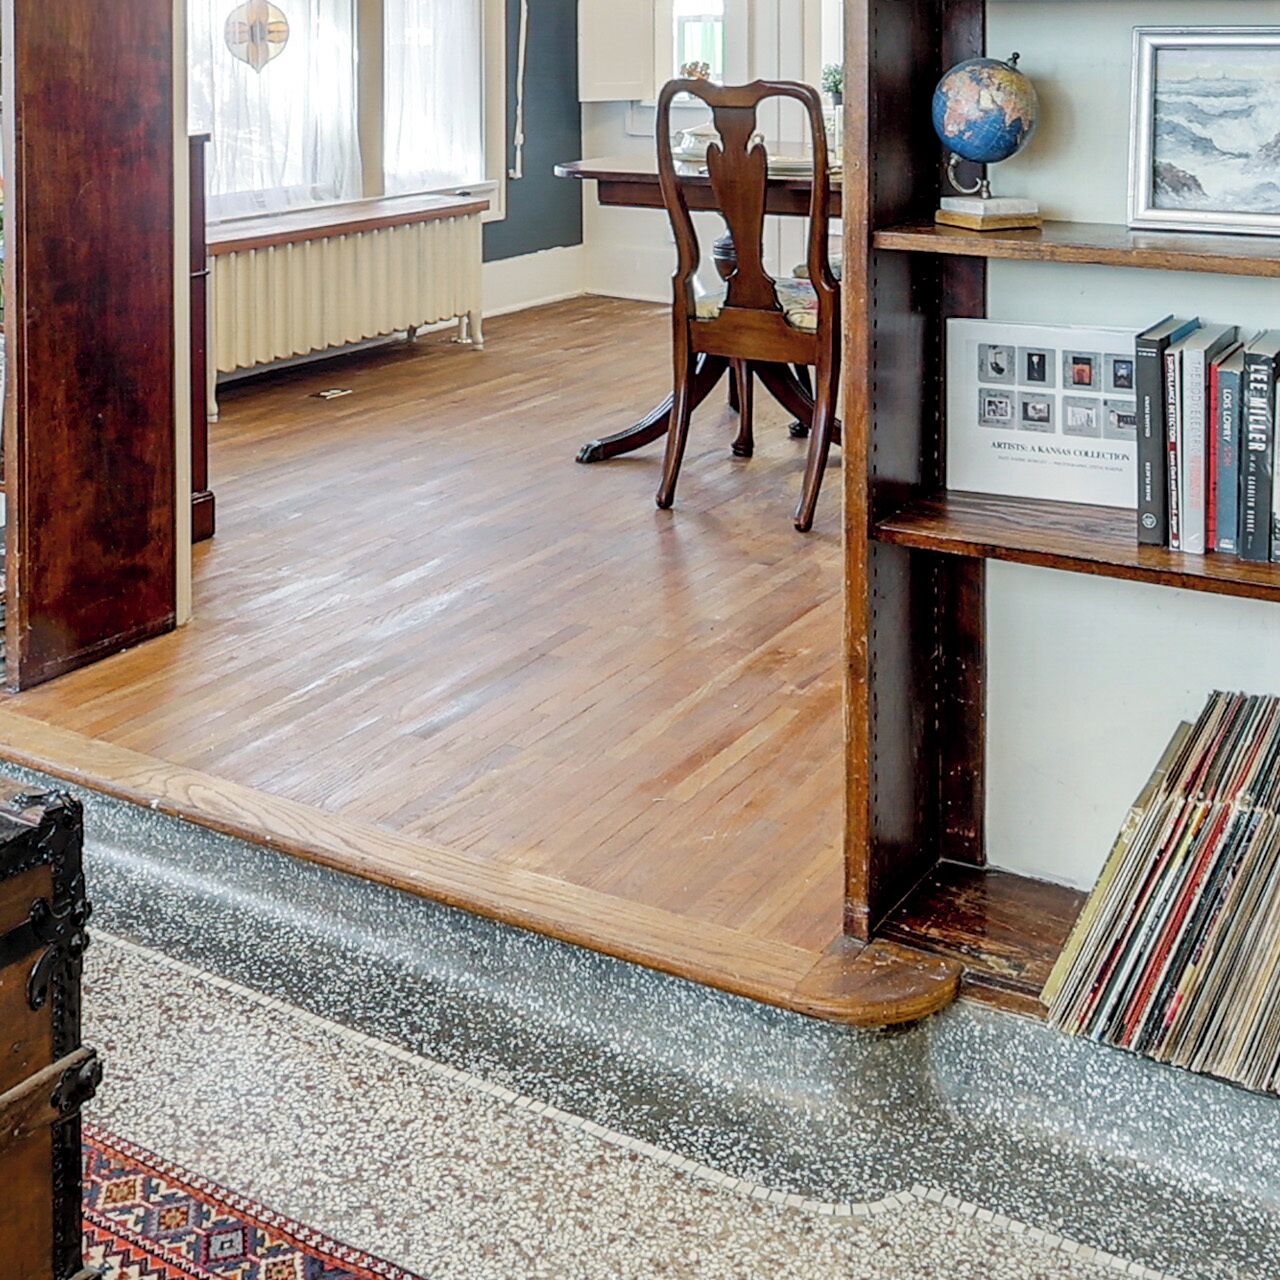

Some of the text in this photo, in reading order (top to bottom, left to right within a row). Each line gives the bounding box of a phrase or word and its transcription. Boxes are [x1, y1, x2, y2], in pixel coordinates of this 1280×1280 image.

[1166, 356, 1176, 442] SURVEILLANCE DETECTION
[1223, 388, 1232, 408] LOIS
[1248, 364, 1268, 452] LEE MILLER
[1222, 411, 1232, 442] LOWRY
[991, 441, 1131, 461] ARTISTS: A KANSAS COLLECTION
